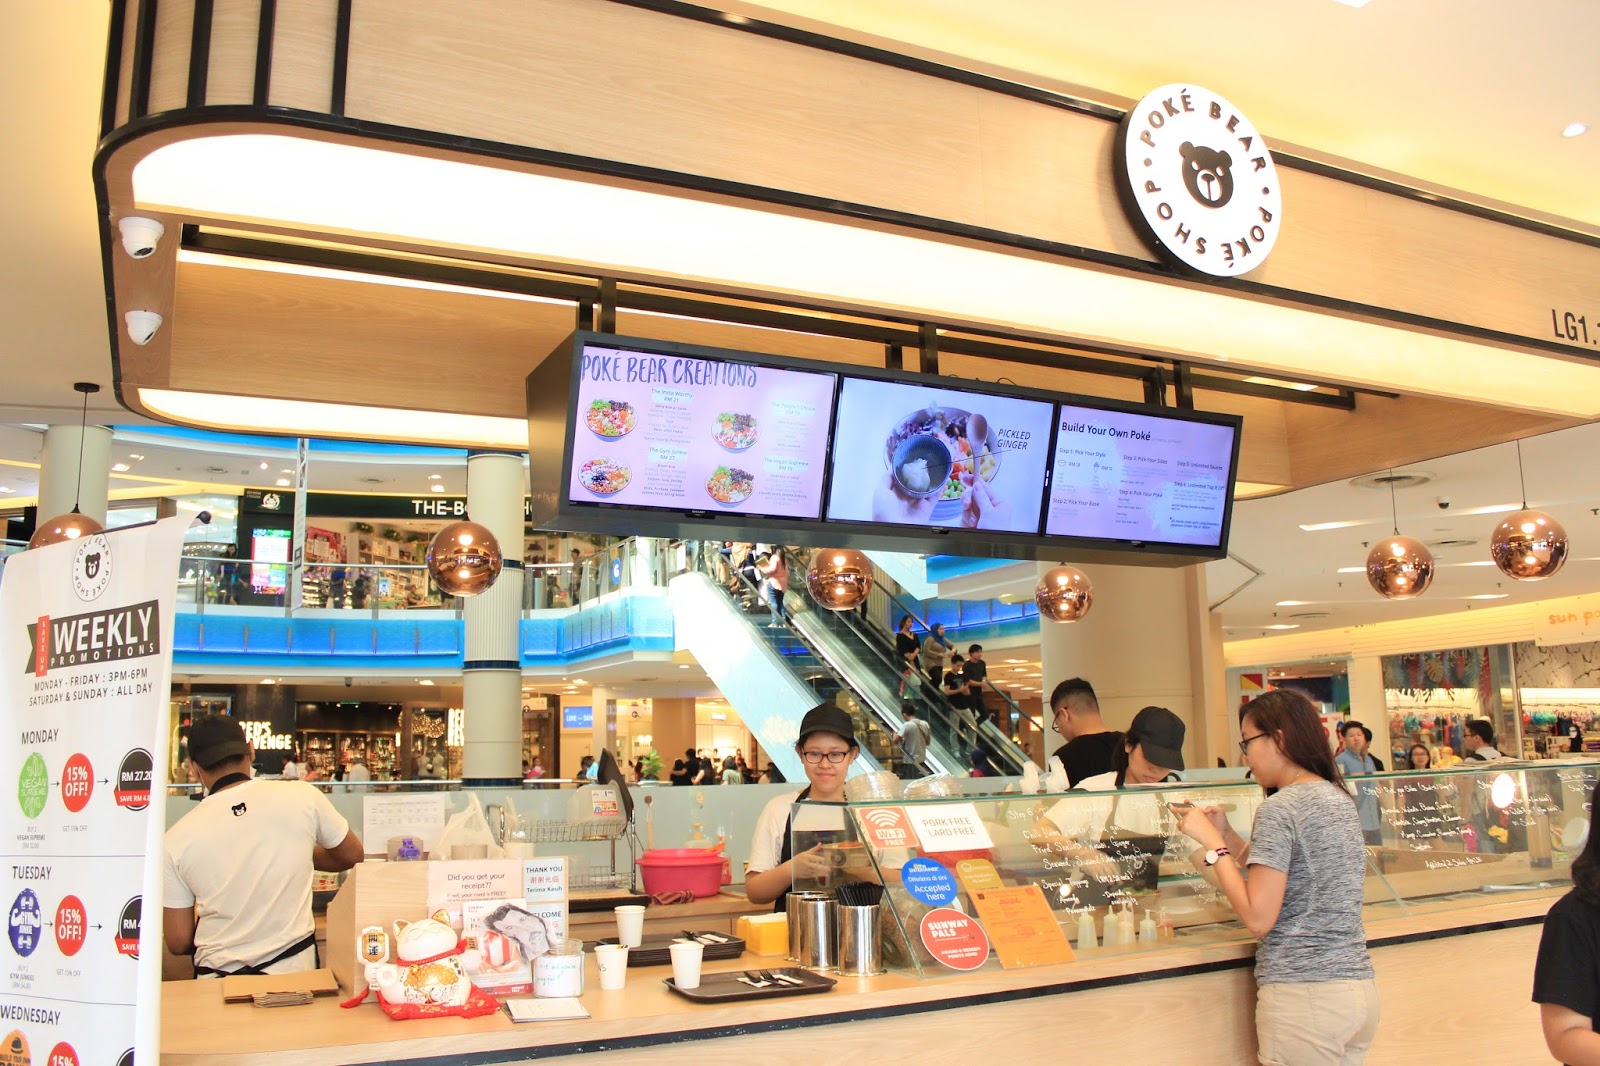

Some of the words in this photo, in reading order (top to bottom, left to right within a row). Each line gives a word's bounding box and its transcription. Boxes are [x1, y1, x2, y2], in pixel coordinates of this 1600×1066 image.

[1140, 88, 1195, 148] POKÉ
[1209, 101, 1267, 173] BEAR
[1144, 179, 1207, 255] SHOP
[1220, 206, 1273, 268] POKÉ
[1551, 308, 1600, 345] LG1.
[582, 351, 621, 382] POKÉ
[626, 357, 667, 384] BEAR
[672, 359, 757, 388] CREATIONS
[998, 428, 1030, 440] PICKLED
[1061, 421, 1084, 434] Build
[1087, 424, 1106, 437] Your
[1107, 427, 1128, 439] Own
[1130, 430, 1151, 442] Poké
[997, 438, 1027, 450] GINGER
[1548, 613, 1578, 625] sun
[53, 606, 153, 655] WEEKLY
[50, 642, 154, 667] PROMOTIONS
[39, 657, 46, 672] UP
[34, 676, 64, 692] MONDAY
[70, 672, 101, 686] FRIDAY
[108, 667, 148, 682] 3PM-6PM
[29, 691, 64, 707] SATURDAY
[65, 691, 71, 702] &
[73, 687, 109, 700] SUNDAY
[117, 685, 133, 696] ALL
[136, 682, 153, 694] DAY
[22, 729, 59, 745] MONDAY
[67, 766, 88, 781] 15%
[121, 771, 133, 782] RM
[65, 782, 88, 797] OFF!
[922, 818, 947, 827] PORK
[949, 817, 972, 826] FREE
[1008, 810, 1026, 821] Step
[928, 828, 953, 838] LARD
[953, 827, 977, 836] FREE
[885, 839, 905, 847] FREE
[12, 865, 52, 880] TUESDAY
[447, 873, 460, 881] Did
[476, 873, 488, 881] get
[489, 872, 505, 880] your
[461, 882, 492, 890] receipt??
[914, 883, 951, 894] Accepted
[925, 892, 946, 900] here
[60, 908, 81, 924] 15%
[123, 918, 137, 929] RM
[59, 924, 82, 940] OFF!
[927, 918, 968, 931] SUNWAY
[930, 928, 957, 938] PALS
[121, 943, 136, 951] SAVE
[1, 1004, 61, 1026] WEDNESDAY
